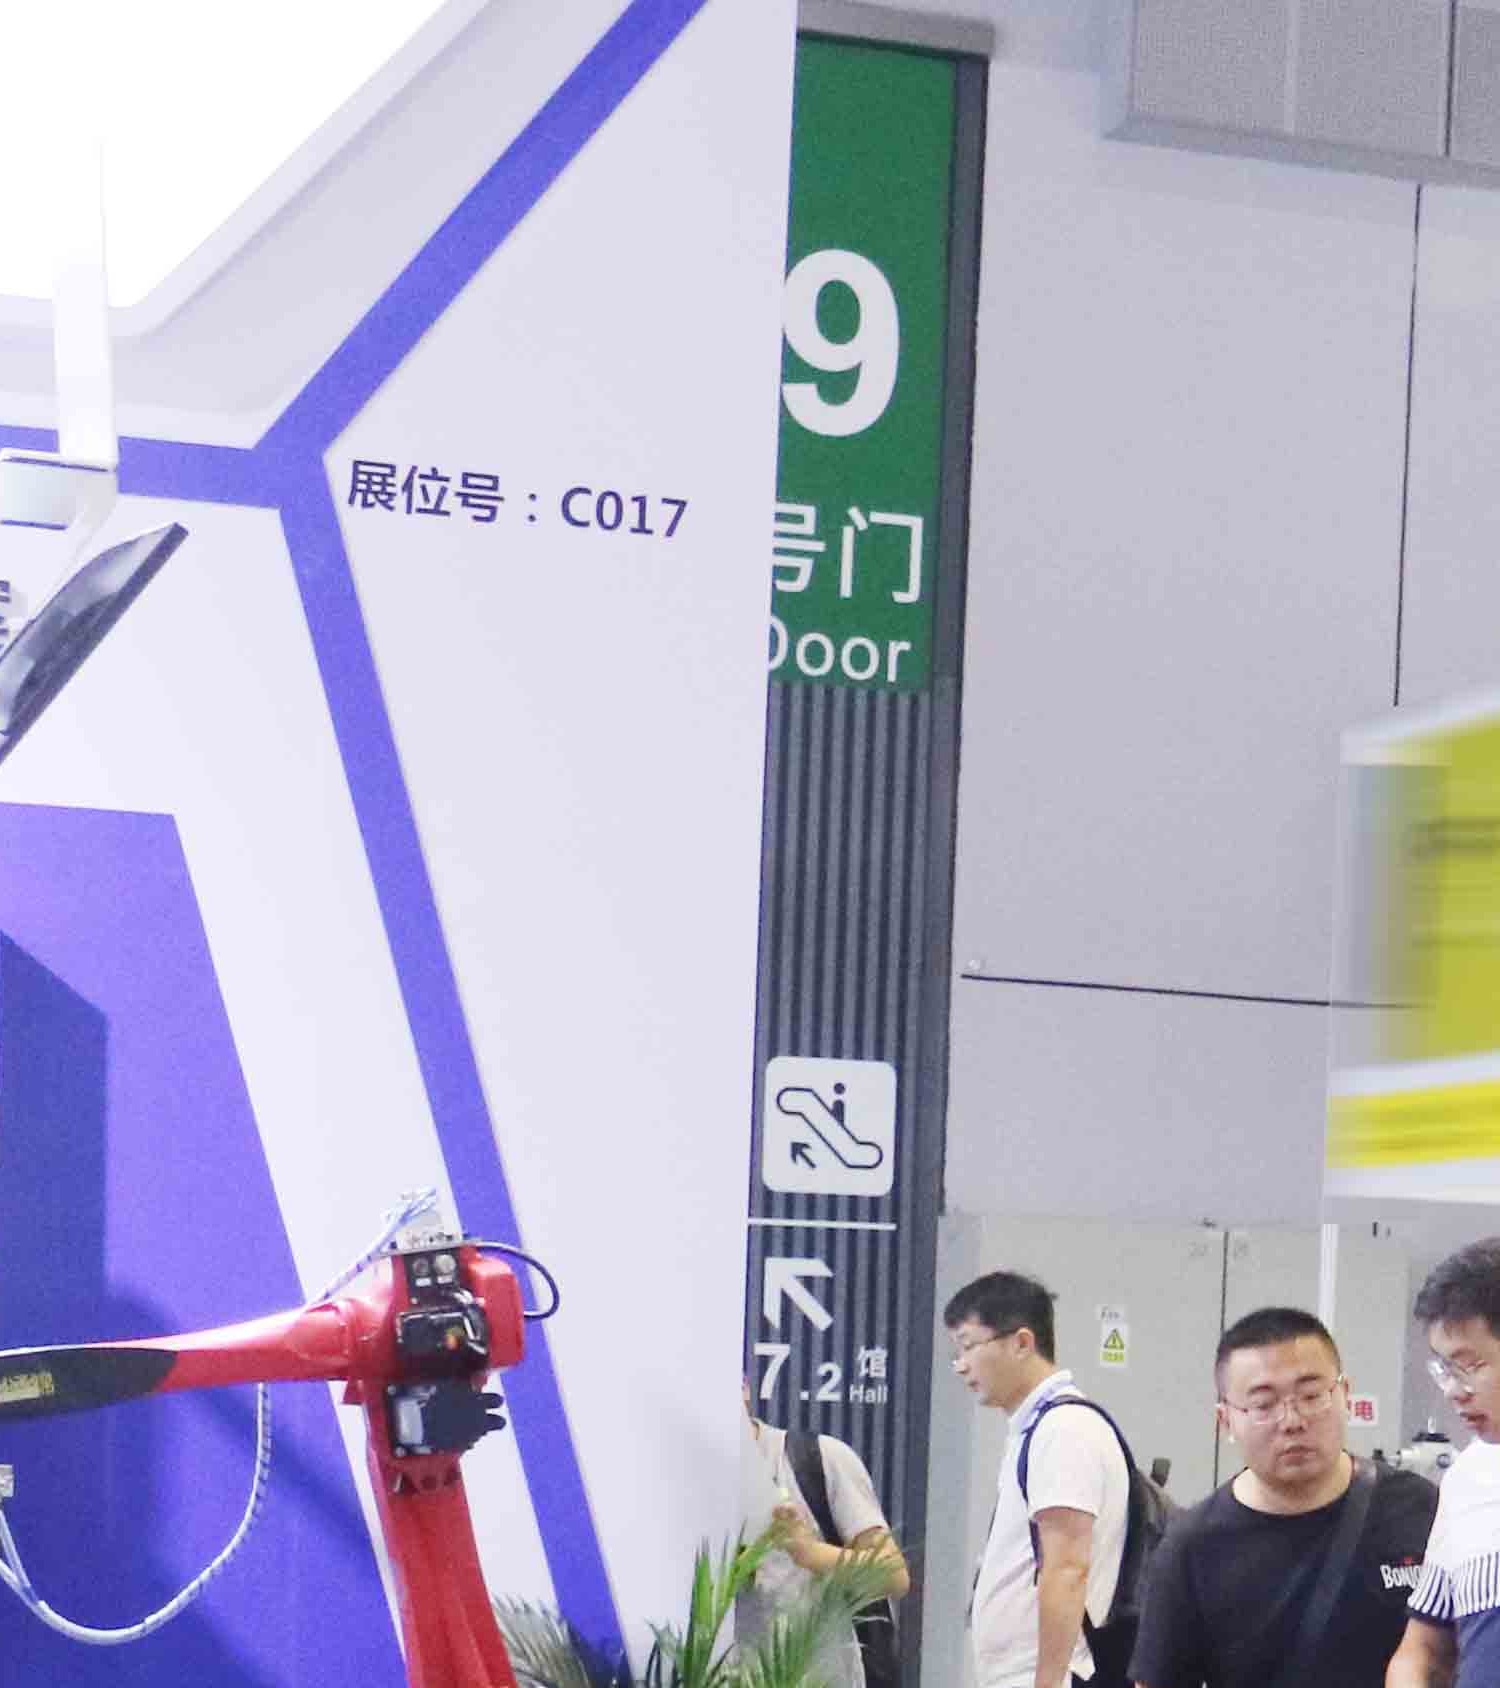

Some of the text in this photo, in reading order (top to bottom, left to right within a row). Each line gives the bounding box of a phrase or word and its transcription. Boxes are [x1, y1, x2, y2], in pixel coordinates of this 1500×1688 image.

[781, 248, 901, 437] 9
[753, 1342, 843, 1402] 7.2
[849, 1383, 889, 1404] Hall
